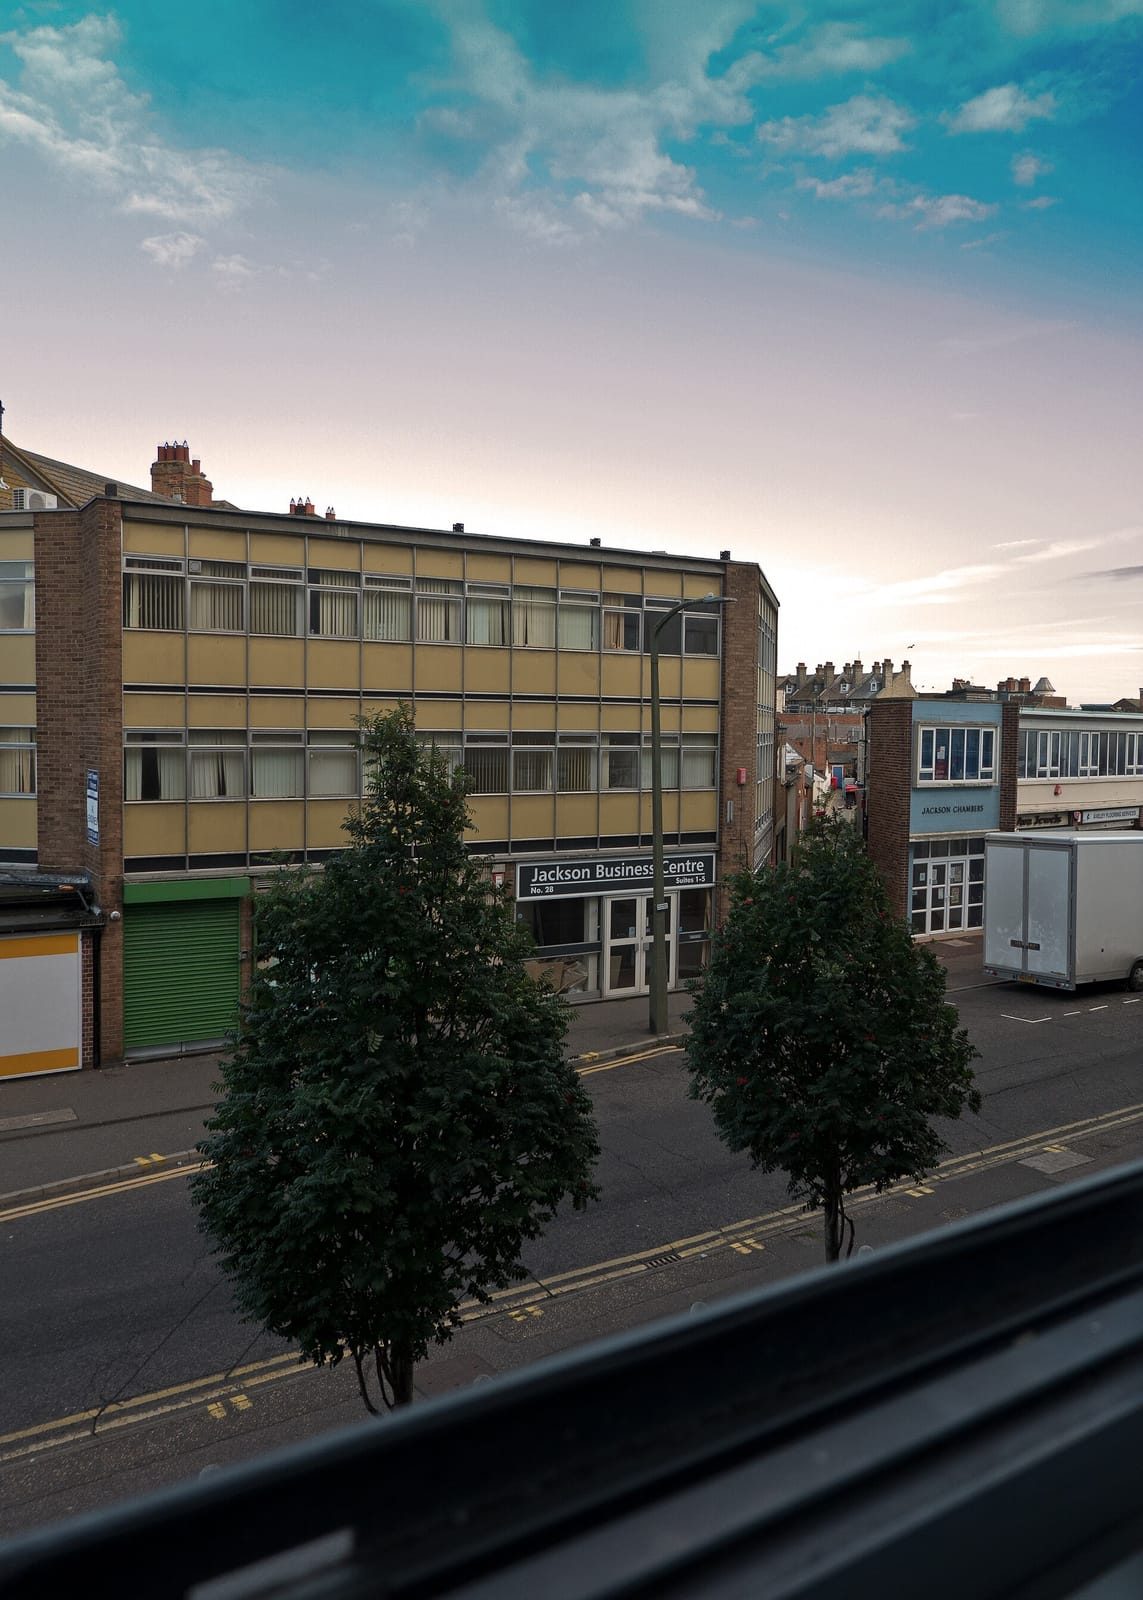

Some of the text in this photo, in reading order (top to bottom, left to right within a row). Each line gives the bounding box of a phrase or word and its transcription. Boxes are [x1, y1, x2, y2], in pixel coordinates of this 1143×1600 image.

[921, 805, 984, 815] JACKSON CHAMBERS
[531, 859, 704, 882] Jackson Business Centre
[695, 875, 706, 883] 1-5
